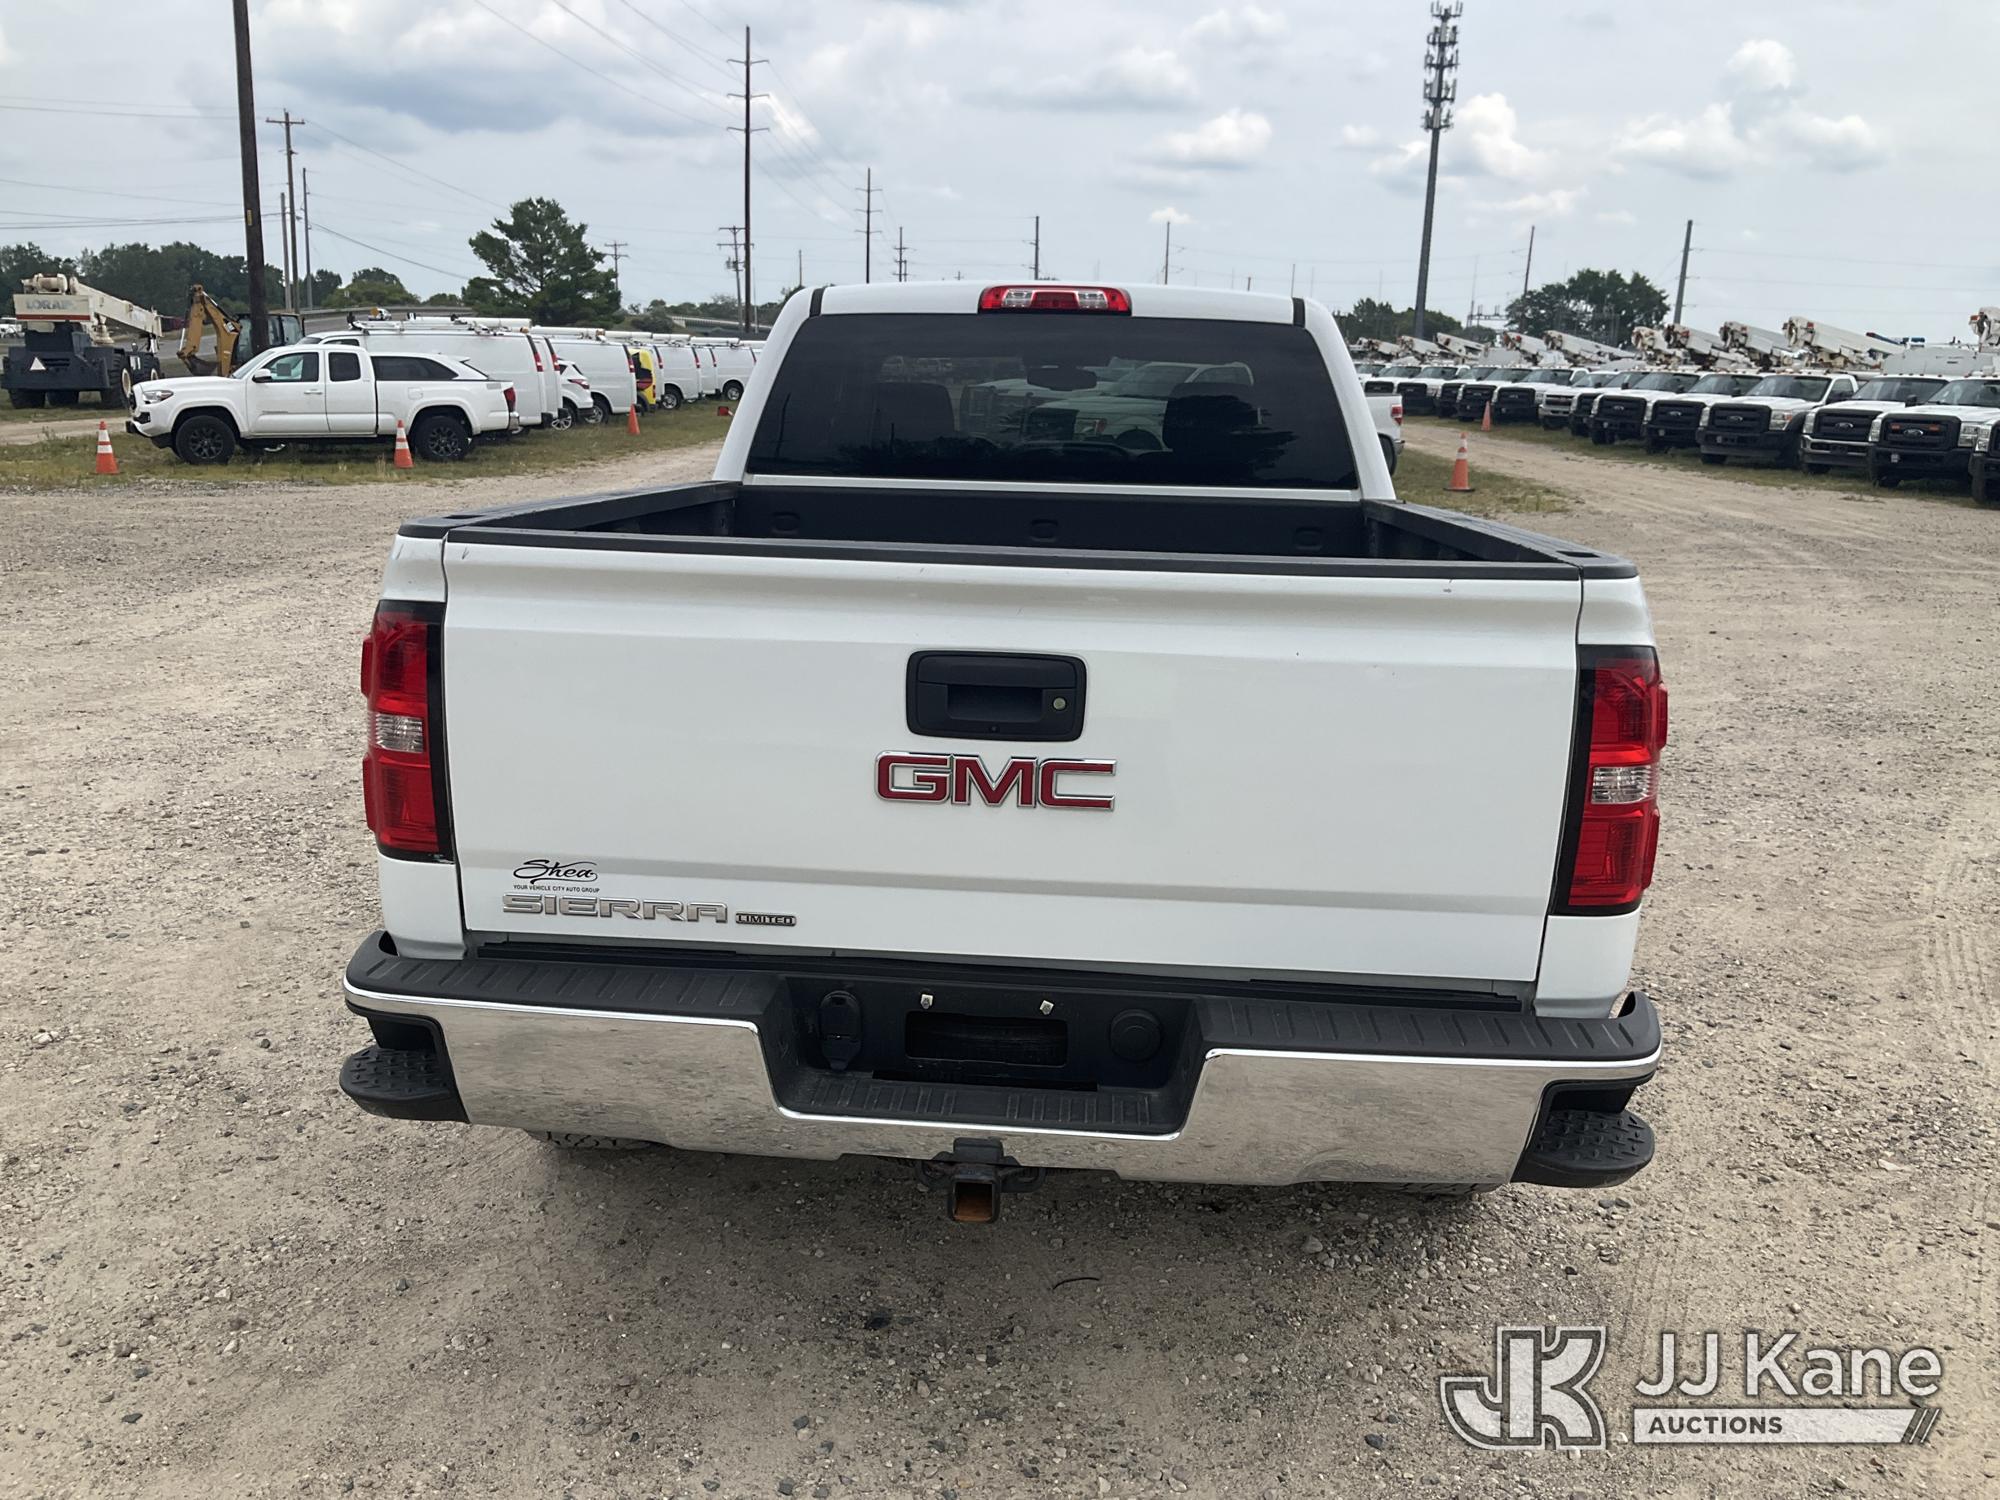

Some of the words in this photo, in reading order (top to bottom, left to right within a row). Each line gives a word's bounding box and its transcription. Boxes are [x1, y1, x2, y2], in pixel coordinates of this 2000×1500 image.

[874, 750, 1118, 812] GMC
[513, 859, 598, 884] Shea
[502, 893, 728, 923] SIERRA
[737, 914, 795, 925] LIMITED
